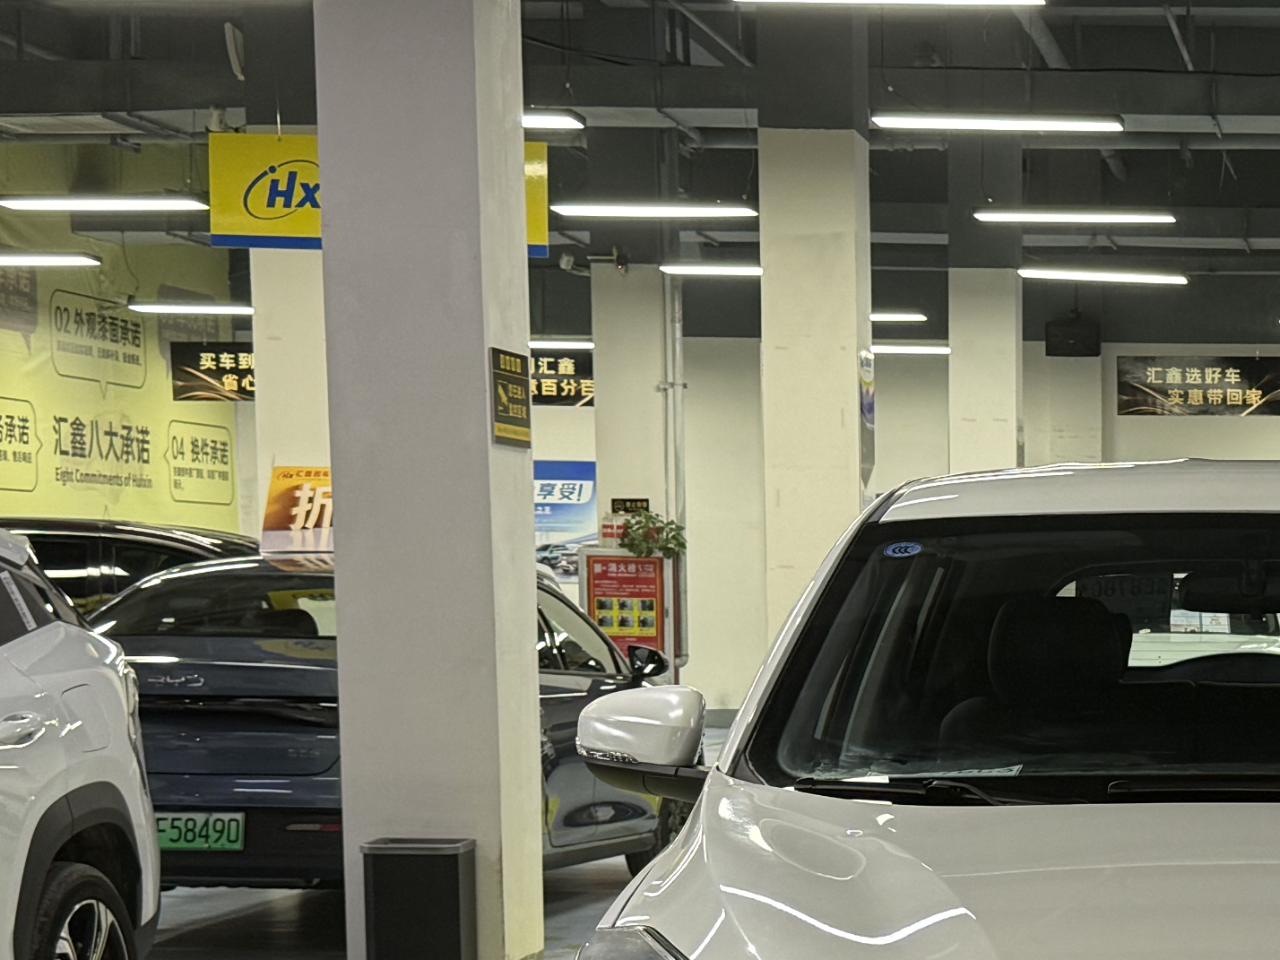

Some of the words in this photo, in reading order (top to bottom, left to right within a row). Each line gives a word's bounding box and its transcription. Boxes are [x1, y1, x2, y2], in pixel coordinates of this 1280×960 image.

[55, 306, 70, 334] 02
[199, 352, 255, 370] 买车到
[222, 374, 256, 391] 省心
[1146, 367, 1241, 384] 汇鑫选好车
[1167, 389, 1262, 405] 实惠带回家
[0, 415, 29, 444] 承诺
[53, 415, 150, 464] 汇鑫八大承诺
[171, 436, 185, 461] 04
[56, 467, 74, 486] Eight
